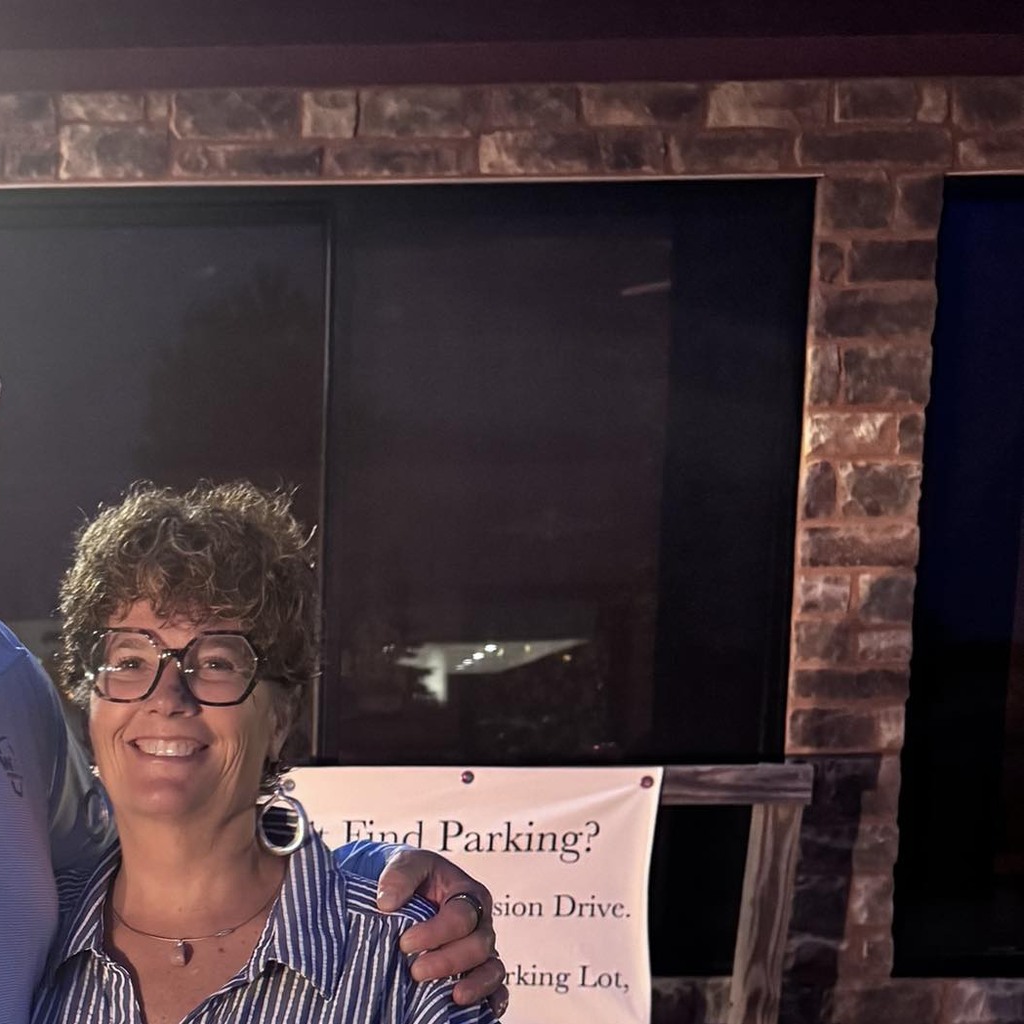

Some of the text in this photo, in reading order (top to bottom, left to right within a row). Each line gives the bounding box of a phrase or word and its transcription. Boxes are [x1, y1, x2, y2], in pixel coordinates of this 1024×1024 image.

[342, 820, 423, 849] Find
[438, 820, 600, 864] Parking?
[491, 894, 631, 918] sion Drive.
[504, 964, 629, 994] rking Lot,
